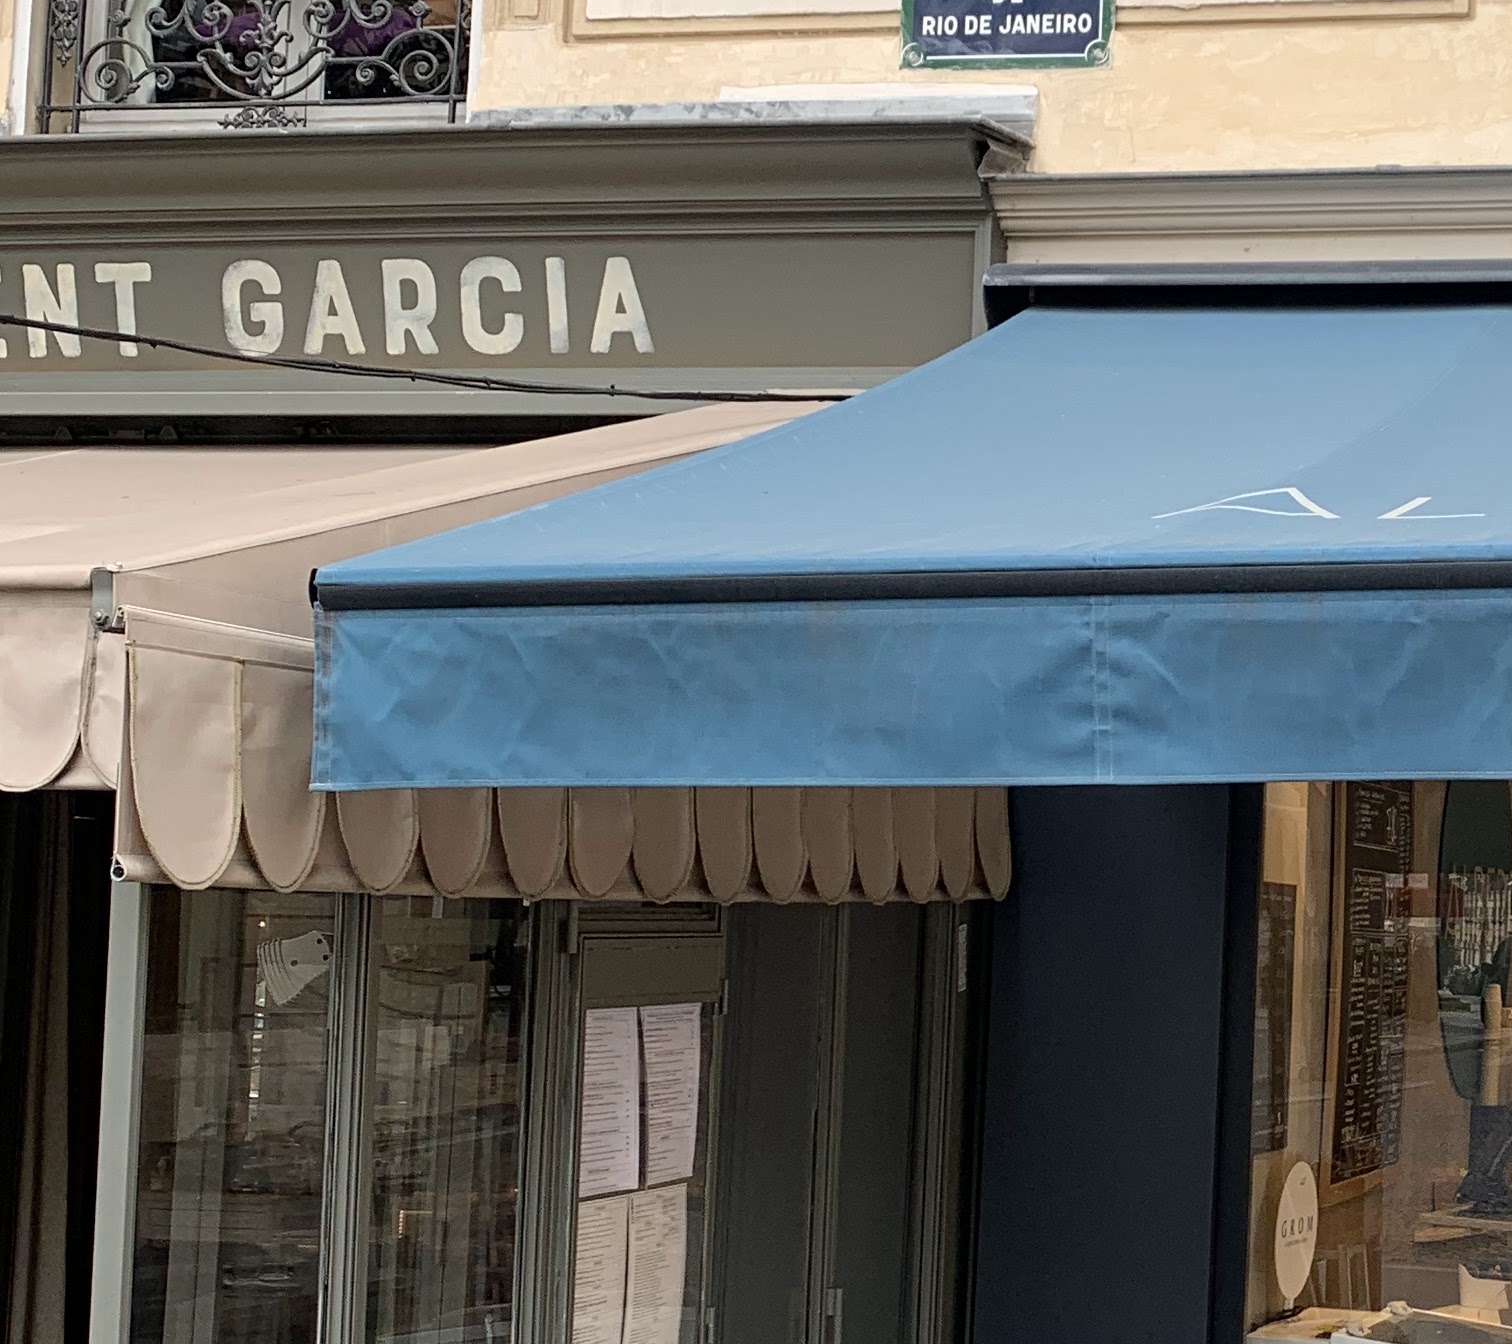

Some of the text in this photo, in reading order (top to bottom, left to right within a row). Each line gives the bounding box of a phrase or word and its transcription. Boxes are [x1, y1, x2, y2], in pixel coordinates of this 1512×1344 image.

[922, 13, 1093, 36] RIO DE JANEIRO
[0, 256, 655, 358] NT GARCIA
[1281, 1215, 1314, 1239] GROM
